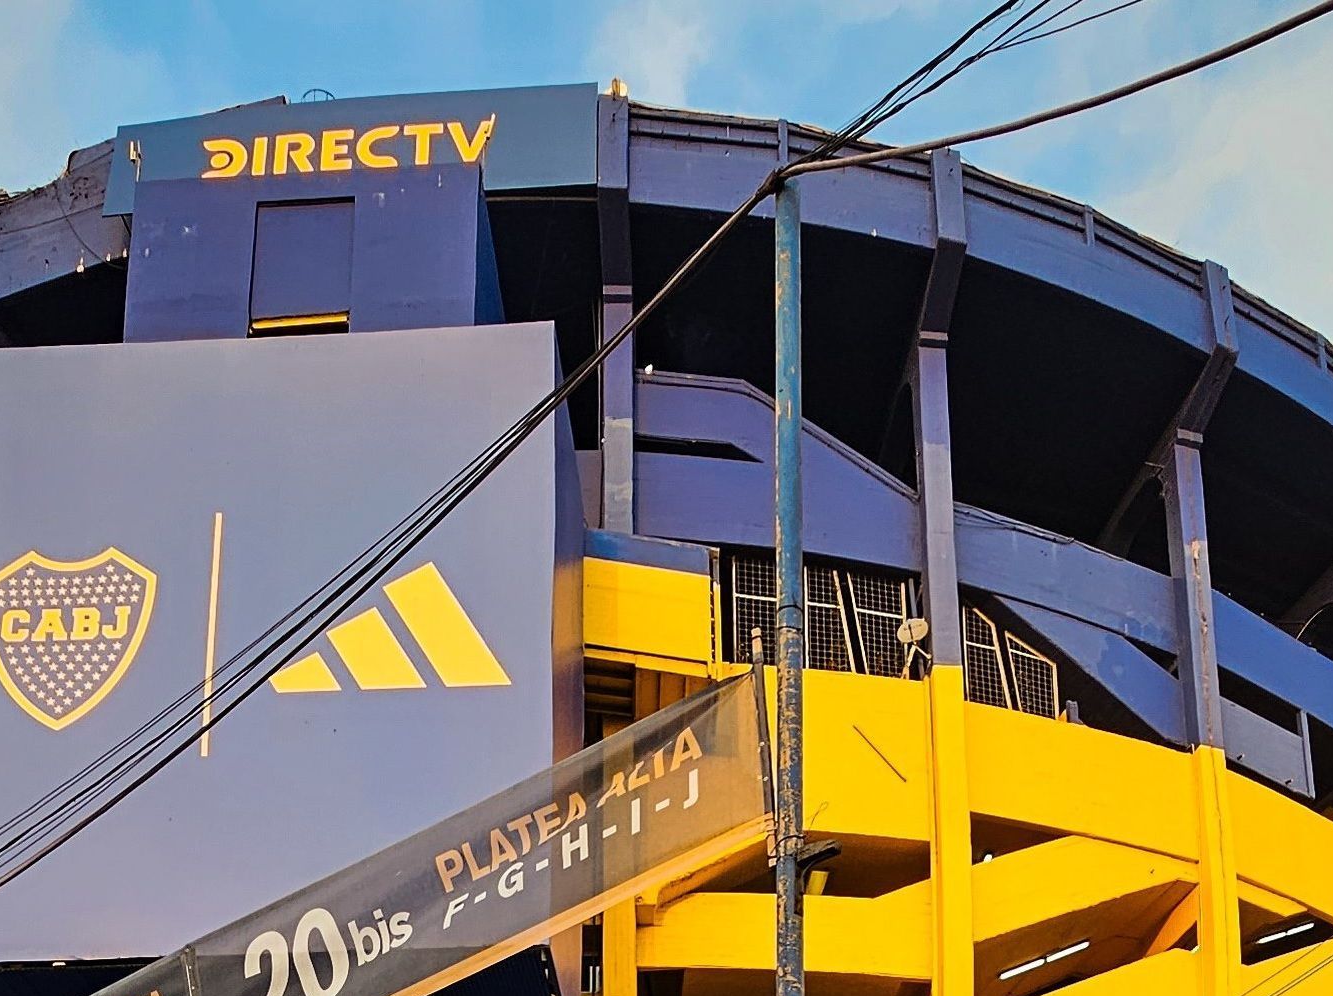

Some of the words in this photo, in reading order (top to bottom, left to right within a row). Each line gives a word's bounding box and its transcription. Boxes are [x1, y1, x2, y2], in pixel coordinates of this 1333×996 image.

[201, 118, 493, 179] DIRECTV
[1, 605, 131, 643] CABJ
[435, 792, 587, 893] PLATEA
